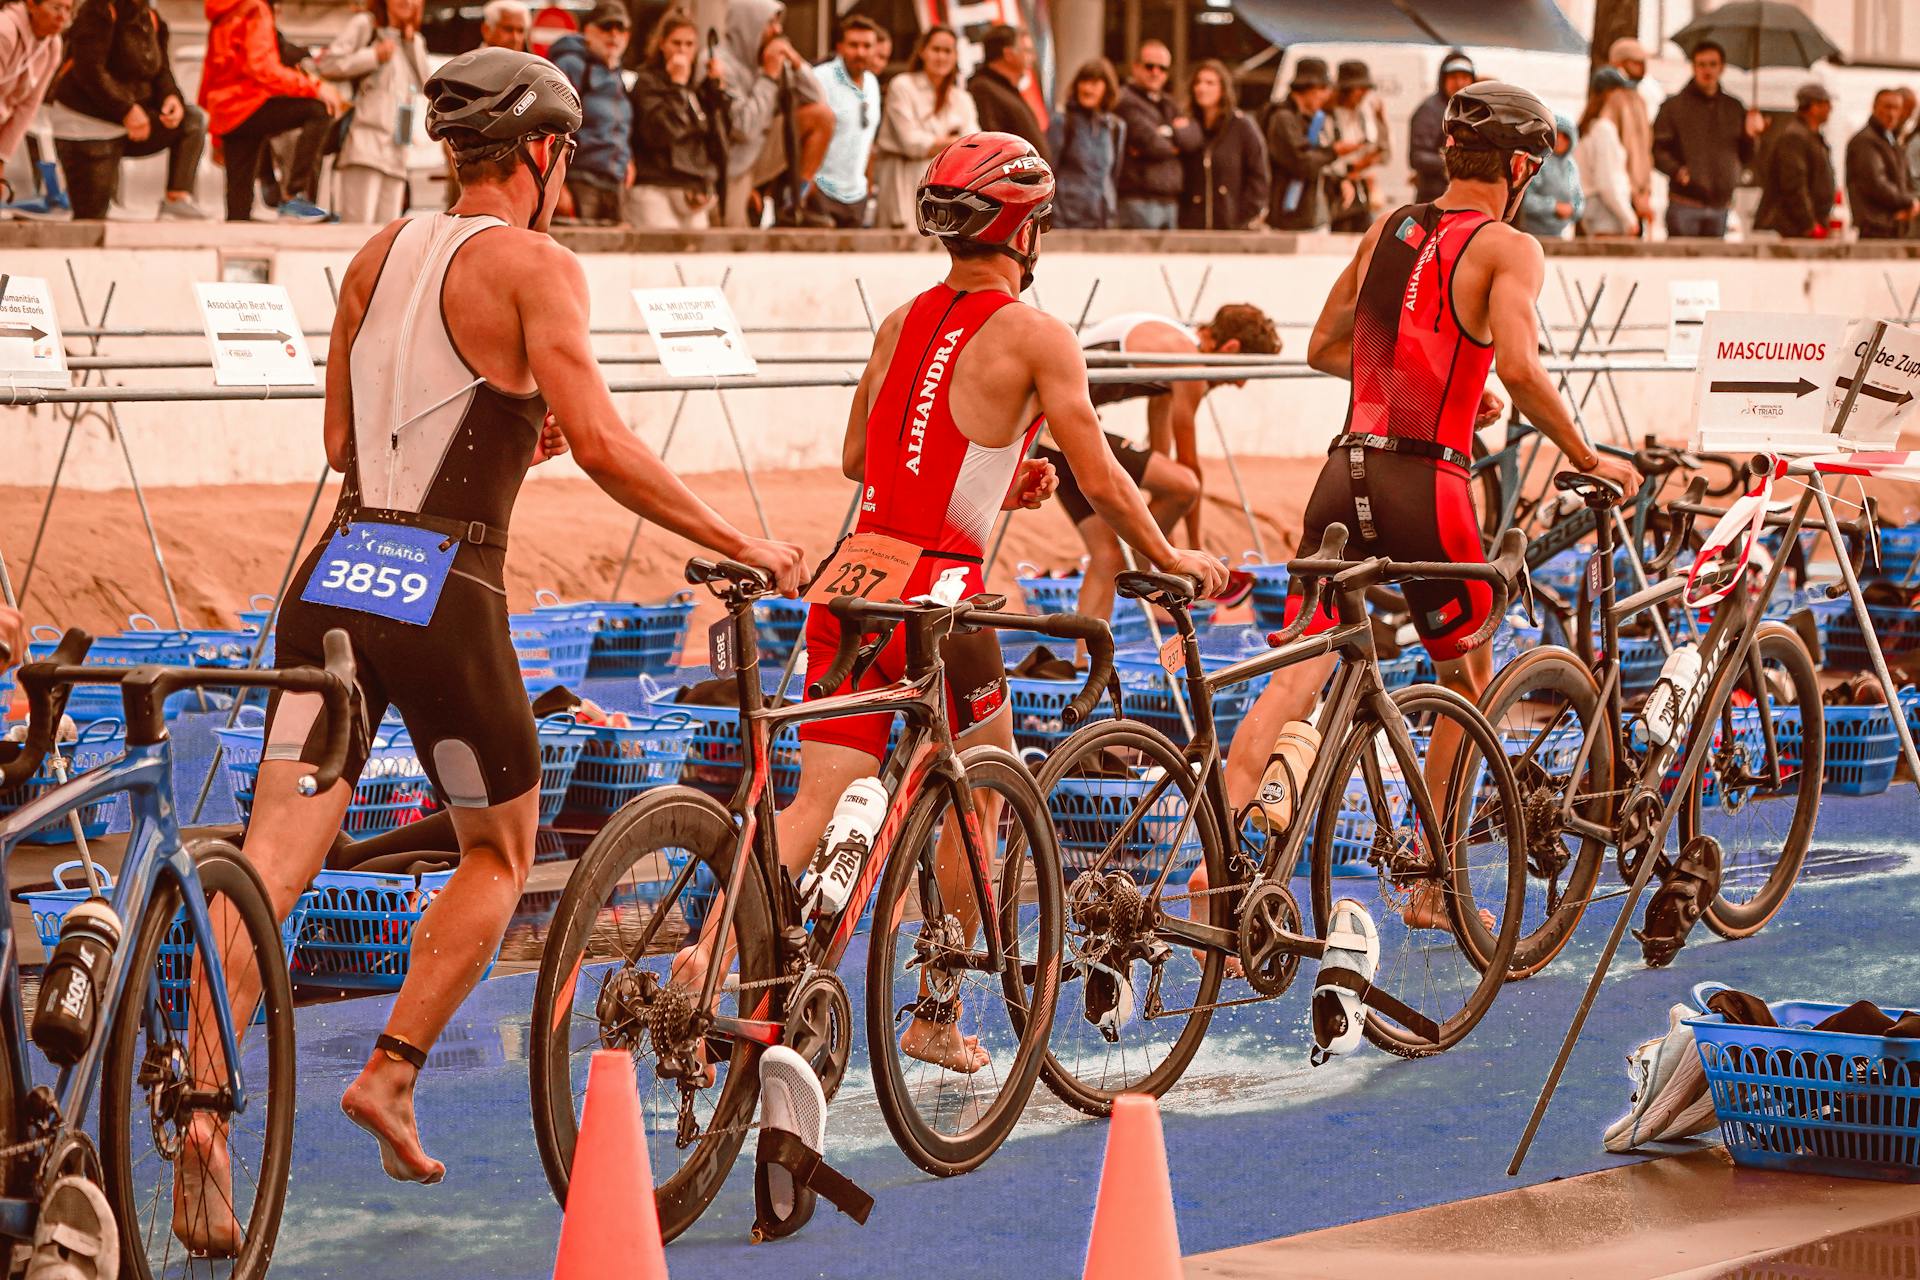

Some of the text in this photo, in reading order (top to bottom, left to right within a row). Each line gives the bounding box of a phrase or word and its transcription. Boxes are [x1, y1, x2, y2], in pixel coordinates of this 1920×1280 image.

[1405, 236, 1437, 312] ALHANDRA
[3, 294, 40, 304] umanitária
[207, 299, 284, 311] Associação Beat Your
[239, 313, 262, 322] Limit!
[1717, 341, 1826, 361] MASCULINOS
[1854, 341, 1895, 367] Cbe
[906, 328, 964, 476] ALHANDRA
[1758, 408, 1784, 416] TRIATLO
[376, 545, 425, 563] TRIATLO
[322, 559, 428, 604] 3859
[824, 562, 888, 598] 237
[716, 632, 727, 671] 3859
[1657, 627, 1732, 778] S-WORKS
[844, 794, 869, 806] 226ERS
[846, 784, 912, 942] GIANT
